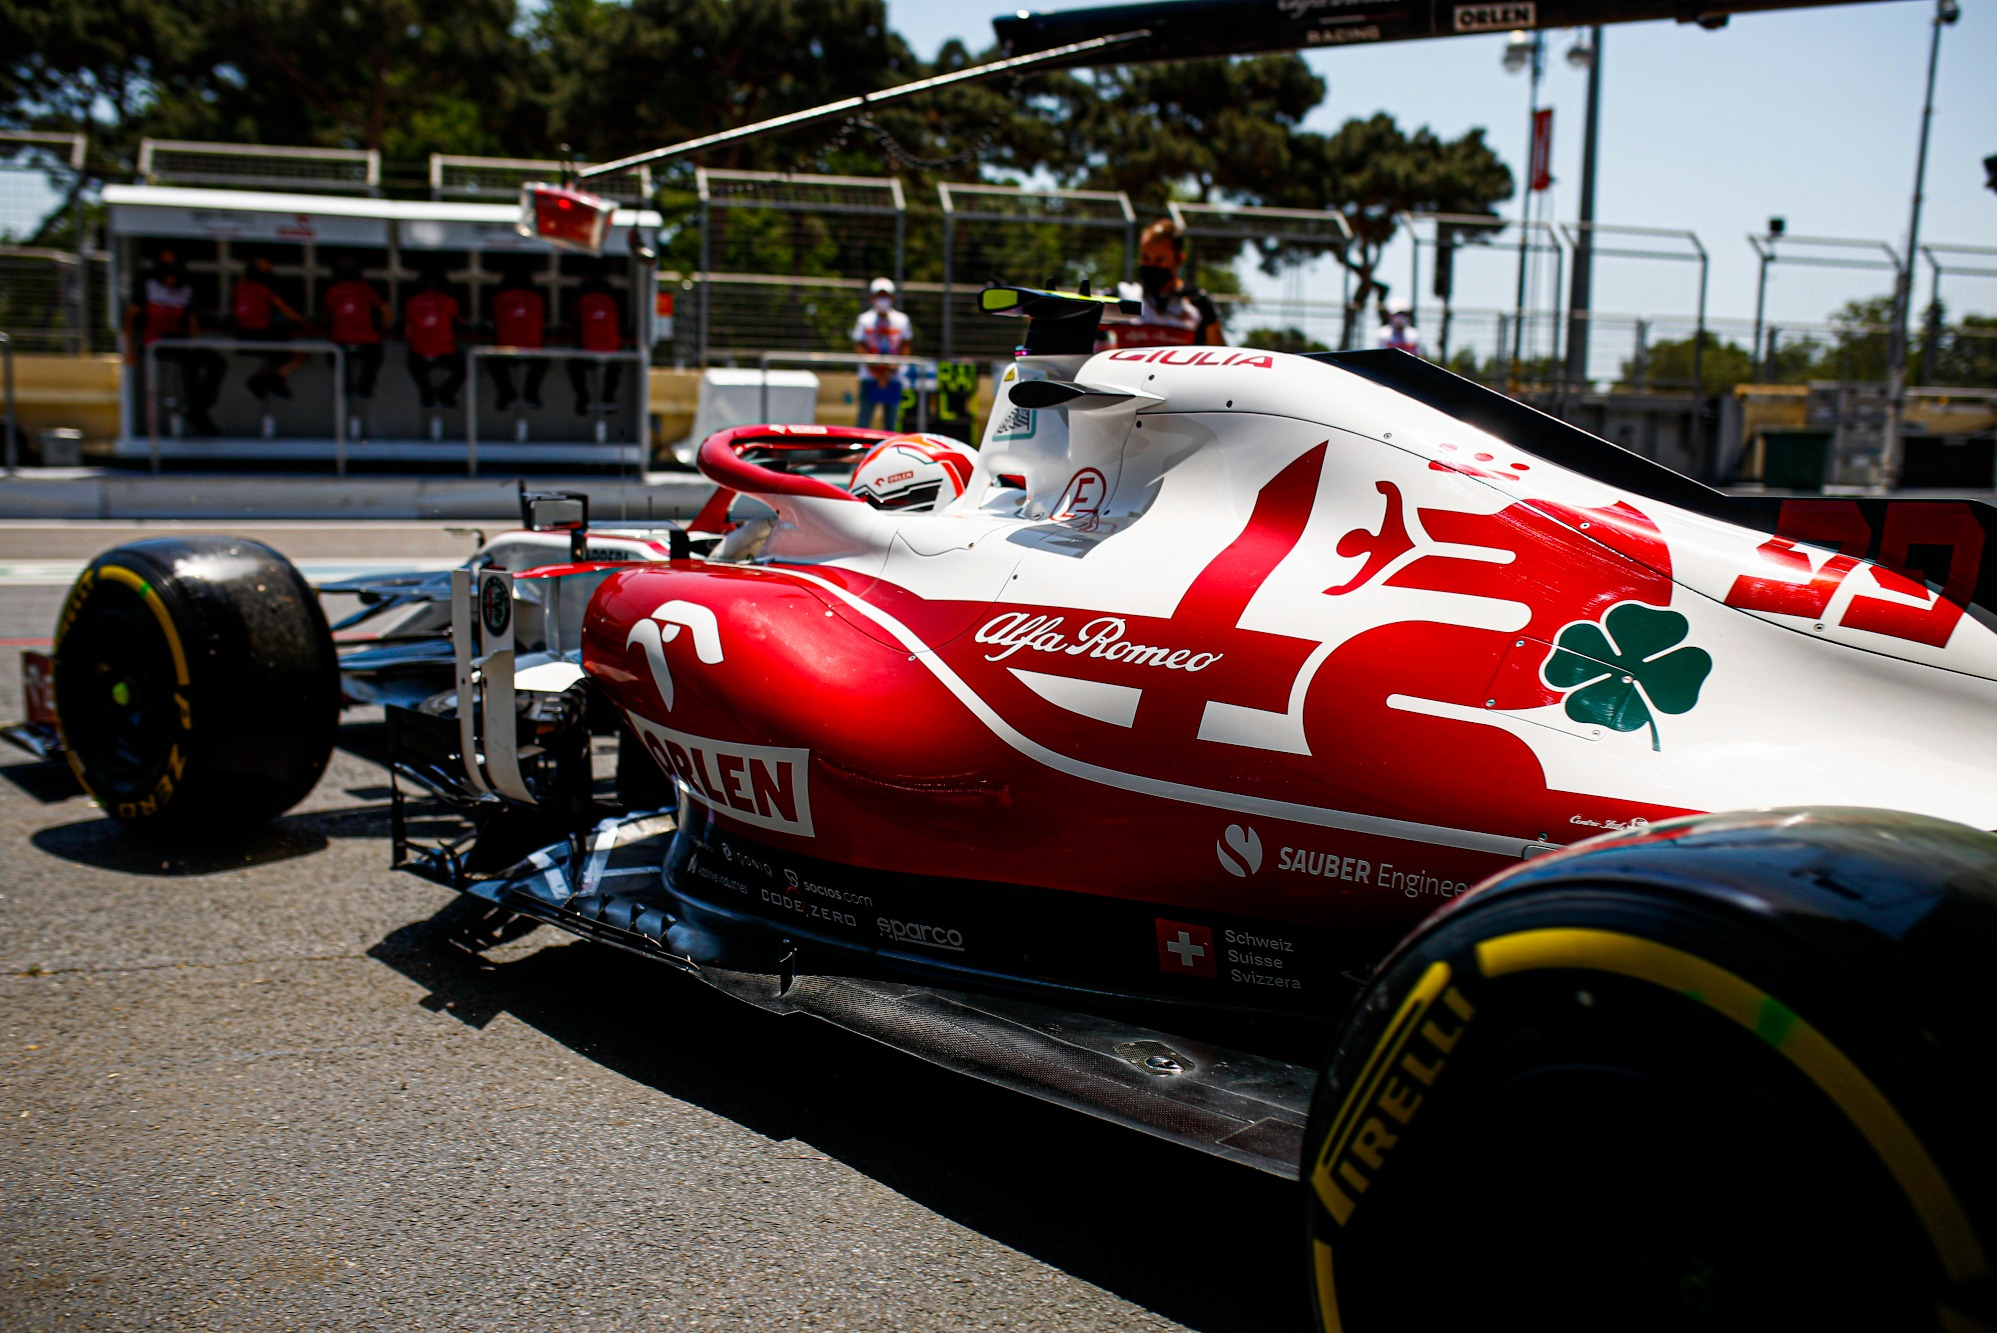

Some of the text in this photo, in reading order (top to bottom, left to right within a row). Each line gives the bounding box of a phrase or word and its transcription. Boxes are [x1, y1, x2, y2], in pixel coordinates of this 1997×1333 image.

[1459, 5, 1530, 25] ORLEN
[1306, 25, 1381, 43] RACING
[1108, 350, 1273, 369] GIULIA
[975, 612, 1224, 672] Alfa Romeo
[118, 742, 188, 820] ZERO
[643, 730, 799, 823] ORLEN
[1277, 846, 1472, 898] SAUBER Enginee
[803, 881, 873, 907] socios.com
[877, 917, 964, 947] sparco
[1225, 930, 1294, 952] Schweiz
[1228, 950, 1284, 969] Suisse
[1230, 969, 1302, 990] Svizzera
[1311, 960, 1477, 1228] PIRELLI
